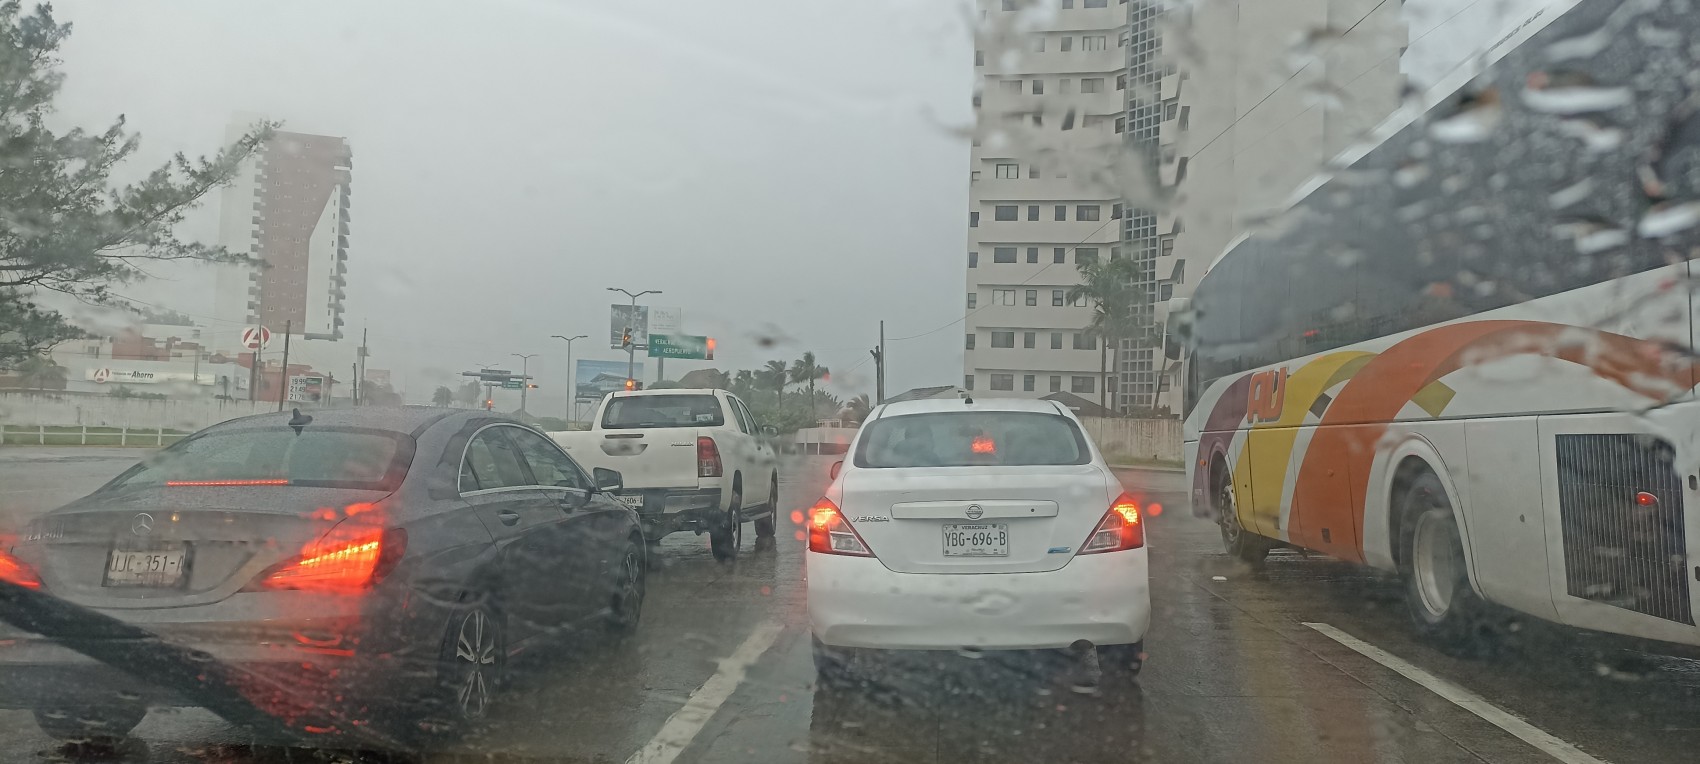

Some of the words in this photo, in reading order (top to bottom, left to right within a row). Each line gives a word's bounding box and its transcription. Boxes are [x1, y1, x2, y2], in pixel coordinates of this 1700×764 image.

[131, 370, 154, 379] Ahorro
[1247, 366, 1288, 424] AU
[944, 531, 1006, 547] YBG-696-B
